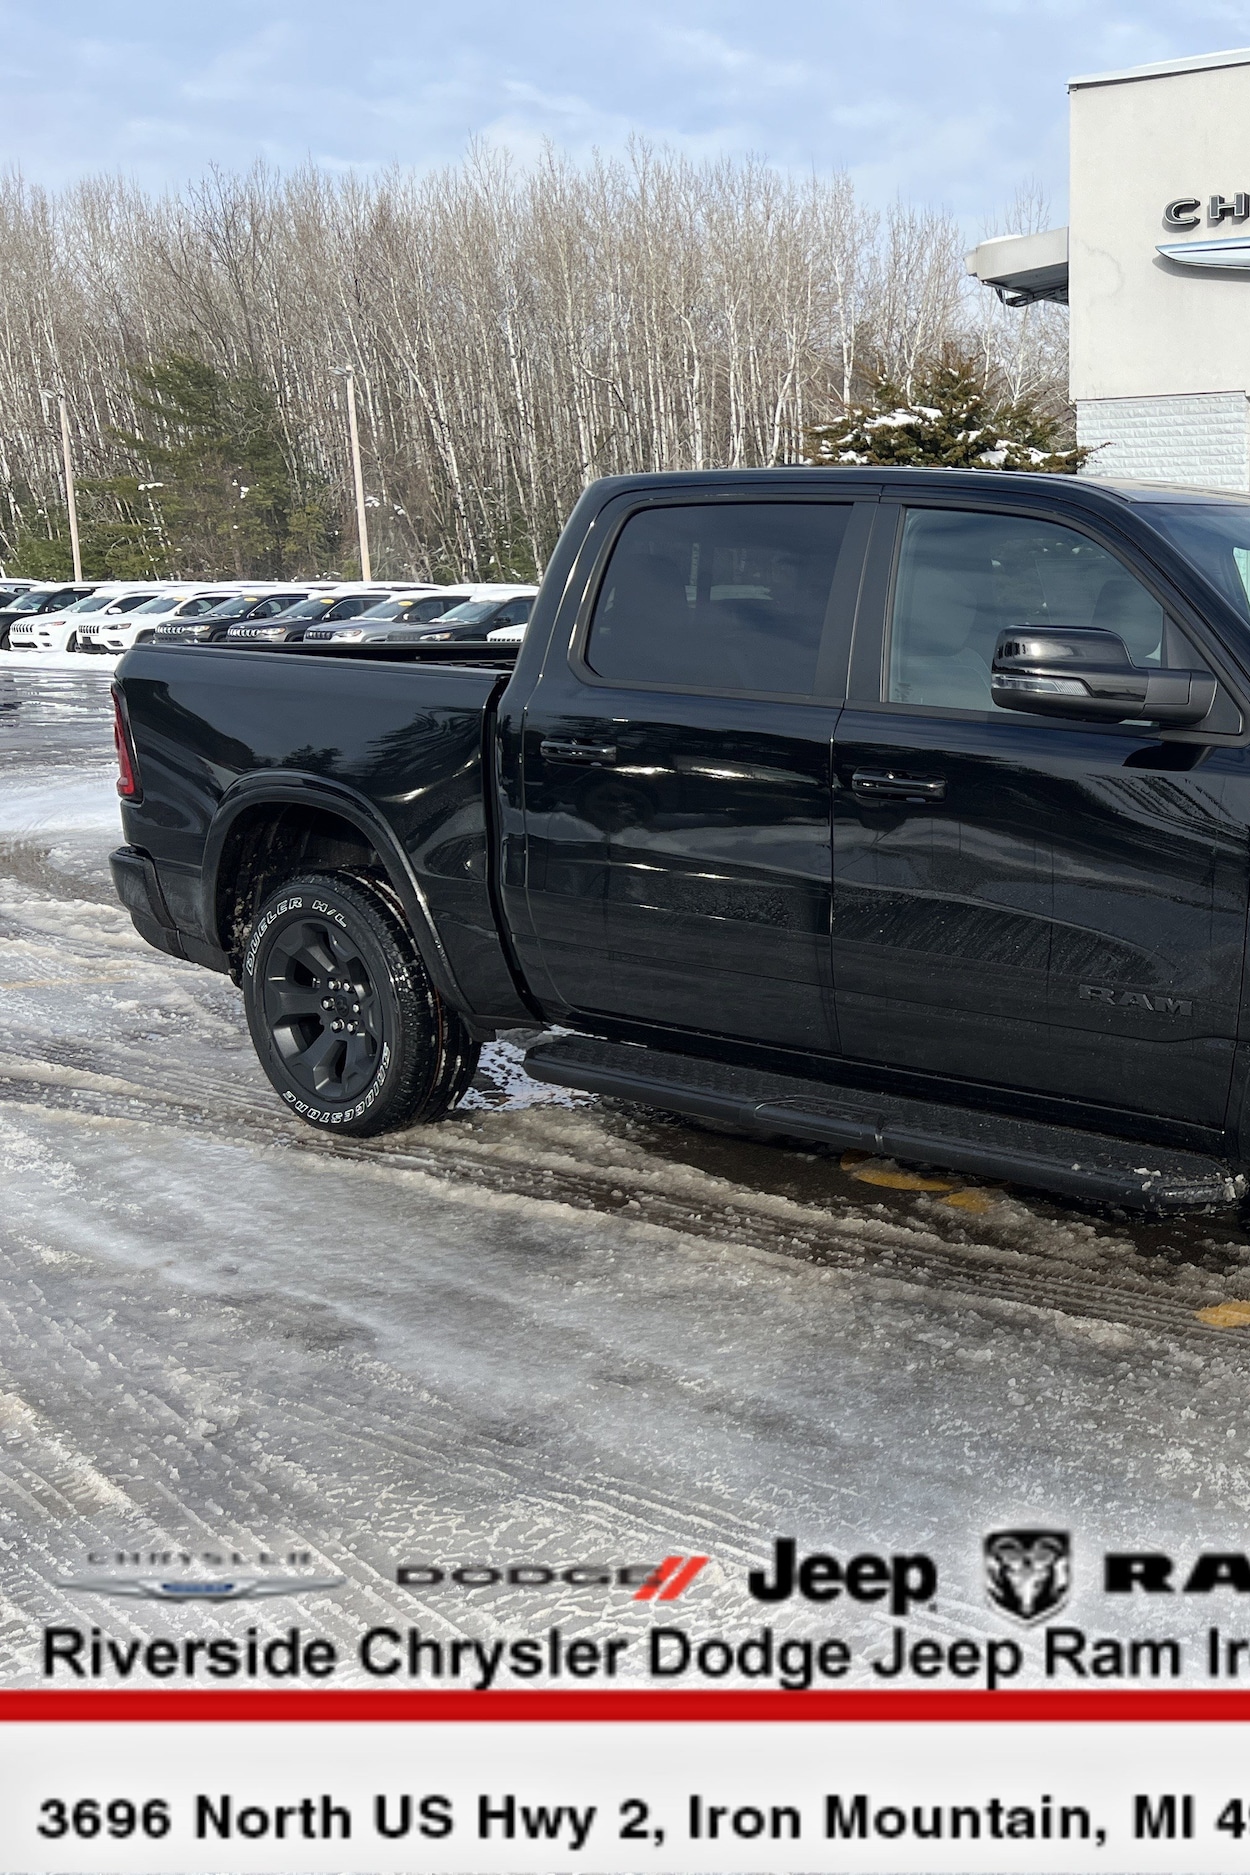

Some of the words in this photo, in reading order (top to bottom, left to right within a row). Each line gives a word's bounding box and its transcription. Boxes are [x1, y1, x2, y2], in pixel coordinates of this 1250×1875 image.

[246, 897, 303, 976] DUELER
[312, 900, 347, 928] H/L
[1079, 984, 1193, 1017] RAM
[283, 1041, 391, 1124] BRIDGESTONE
